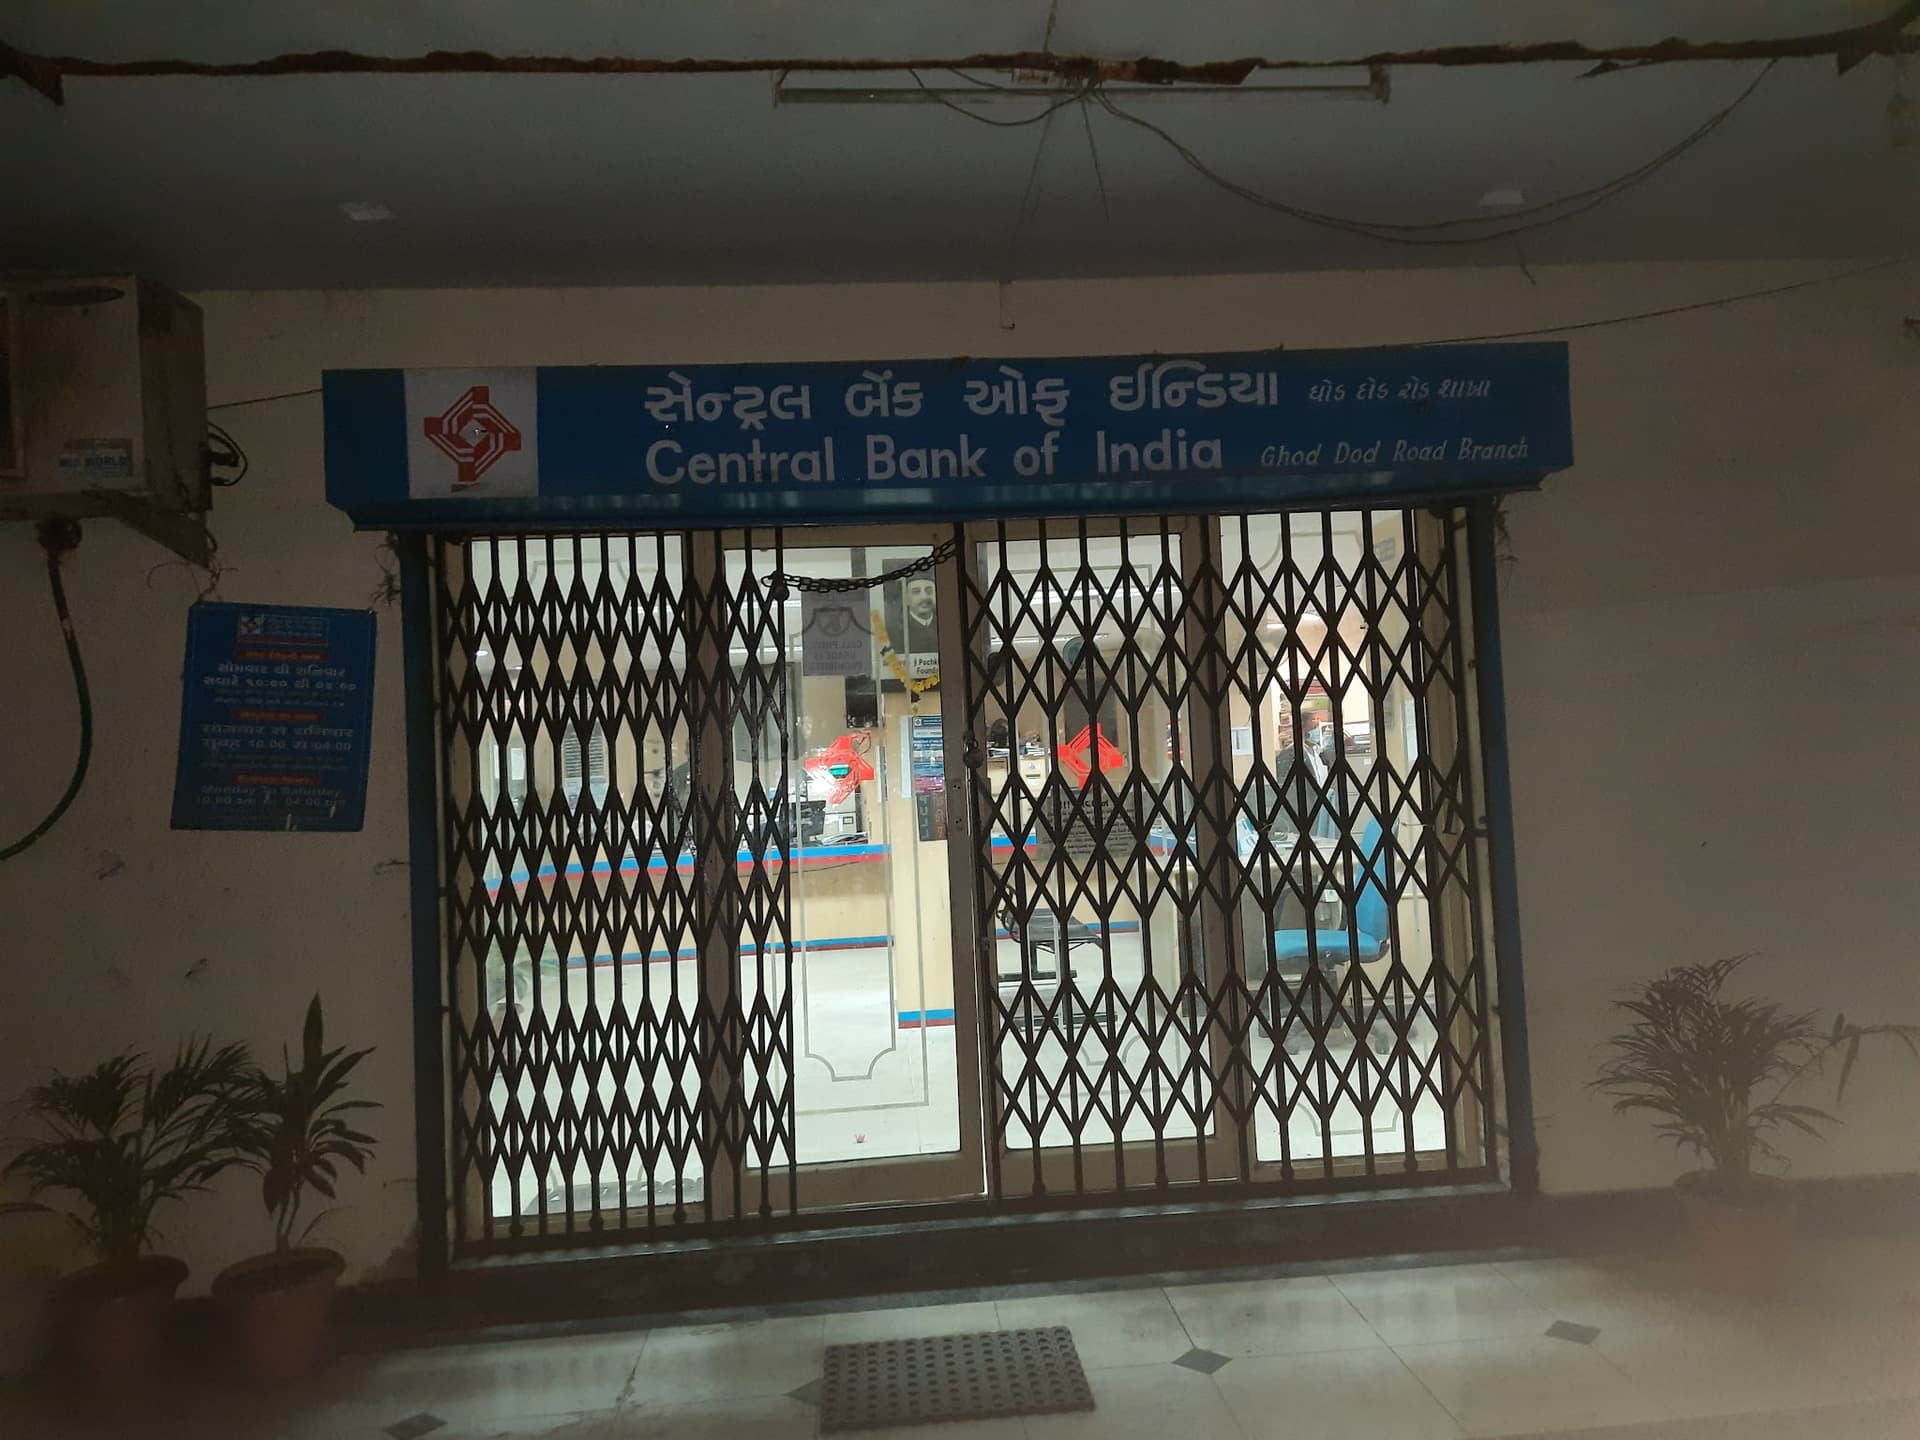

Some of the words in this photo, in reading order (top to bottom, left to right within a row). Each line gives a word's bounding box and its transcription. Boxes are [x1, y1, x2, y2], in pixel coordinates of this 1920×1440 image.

[645, 370, 811, 430] સેન્ટ્રલ
[964, 364, 1070, 427] ઓફ
[1356, 376, 1390, 401] દોડ
[645, 435, 836, 486] Central
[865, 433, 988, 481] Bank
[1014, 428, 1061, 476] of
[1096, 428, 1223, 474] India
[1261, 443, 1323, 468] Ghod
[1334, 440, 1382, 465] Dod
[1392, 438, 1448, 464] Road
[1457, 435, 1529, 462] Branch
